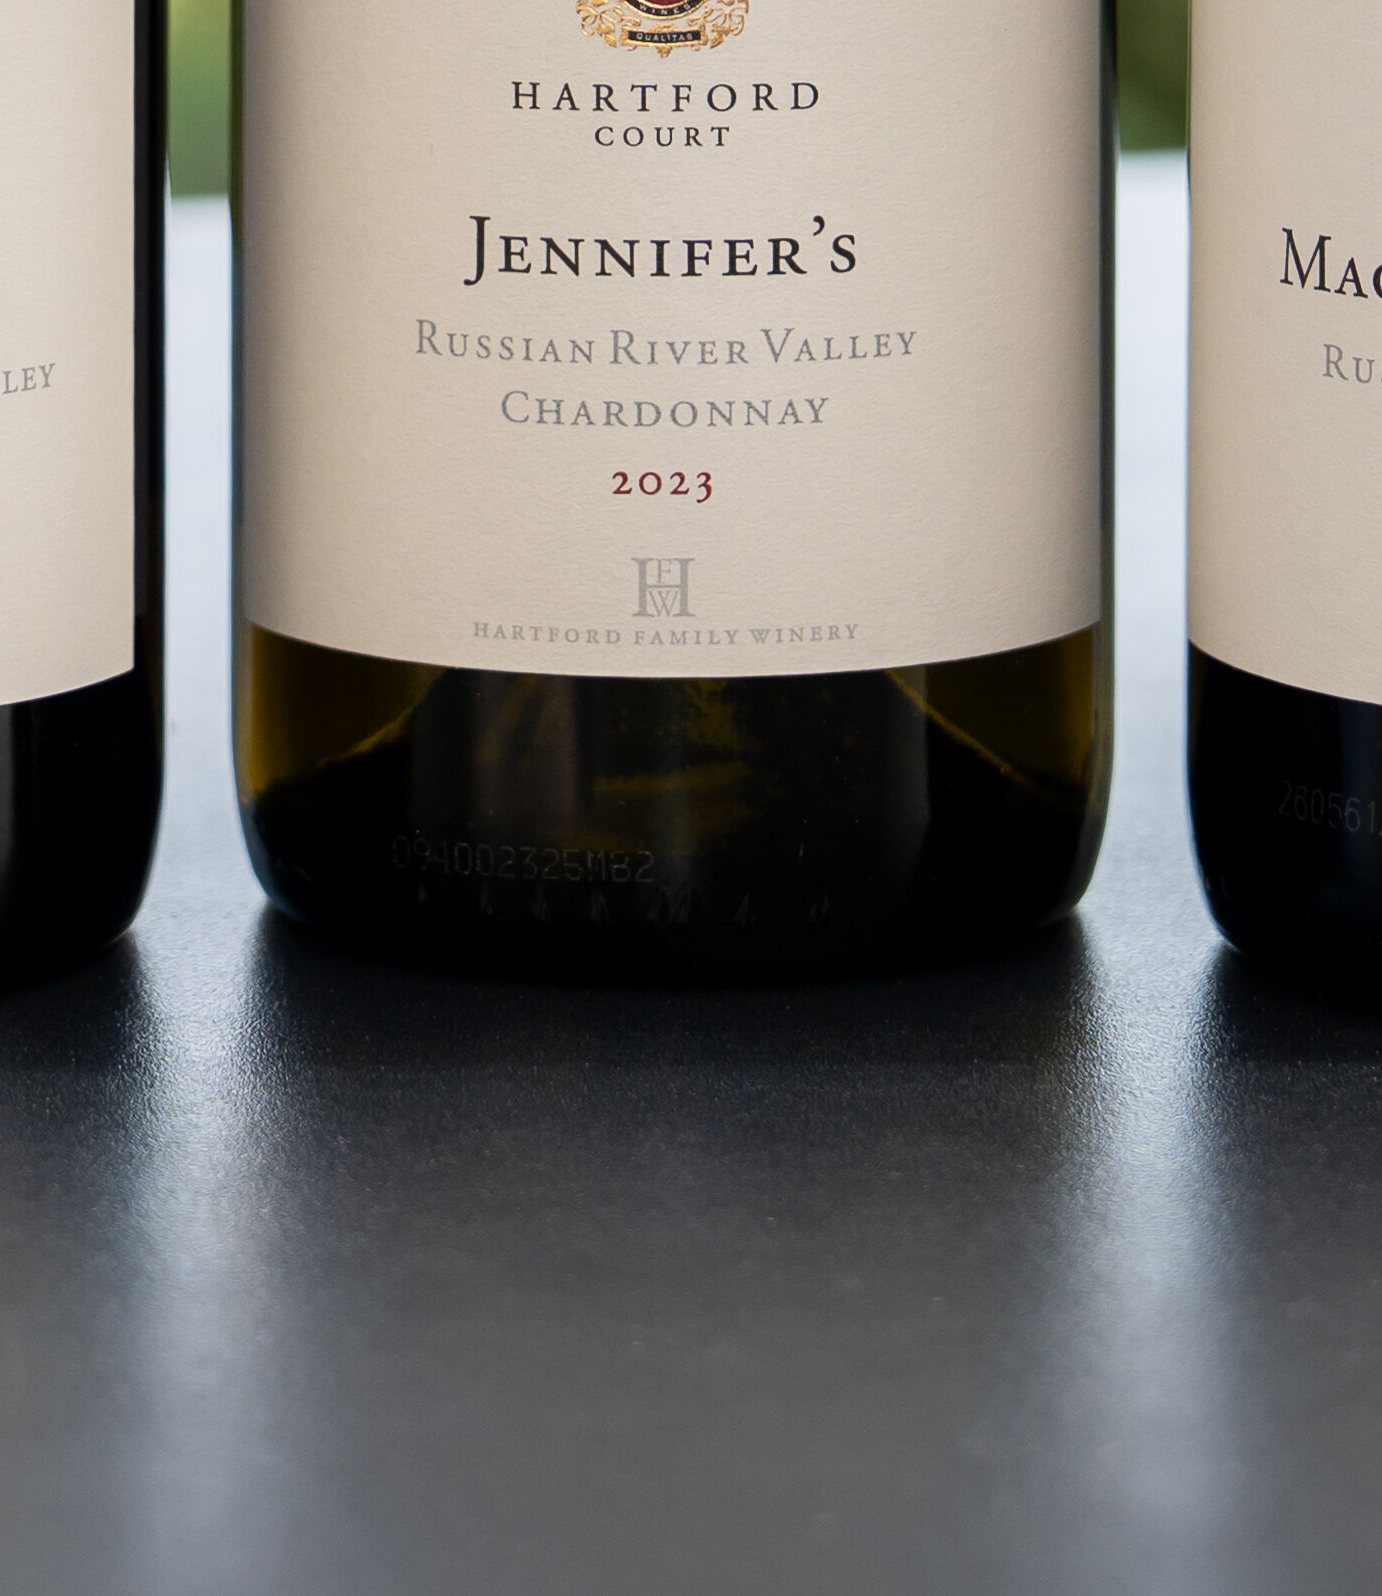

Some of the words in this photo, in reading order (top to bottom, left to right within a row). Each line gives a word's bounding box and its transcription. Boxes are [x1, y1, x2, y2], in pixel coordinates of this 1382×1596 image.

[638, 1, 693, 17] WINES
[635, 30, 695, 43] QUALITAS
[511, 81, 820, 113] HARTFORD
[594, 126, 730, 148] COURT
[612, 471, 713, 504] 2023
[472, 620, 621, 645] HARTFORD
[633, 629, 740, 646] FAMILY
[748, 623, 860, 645] WINERY
